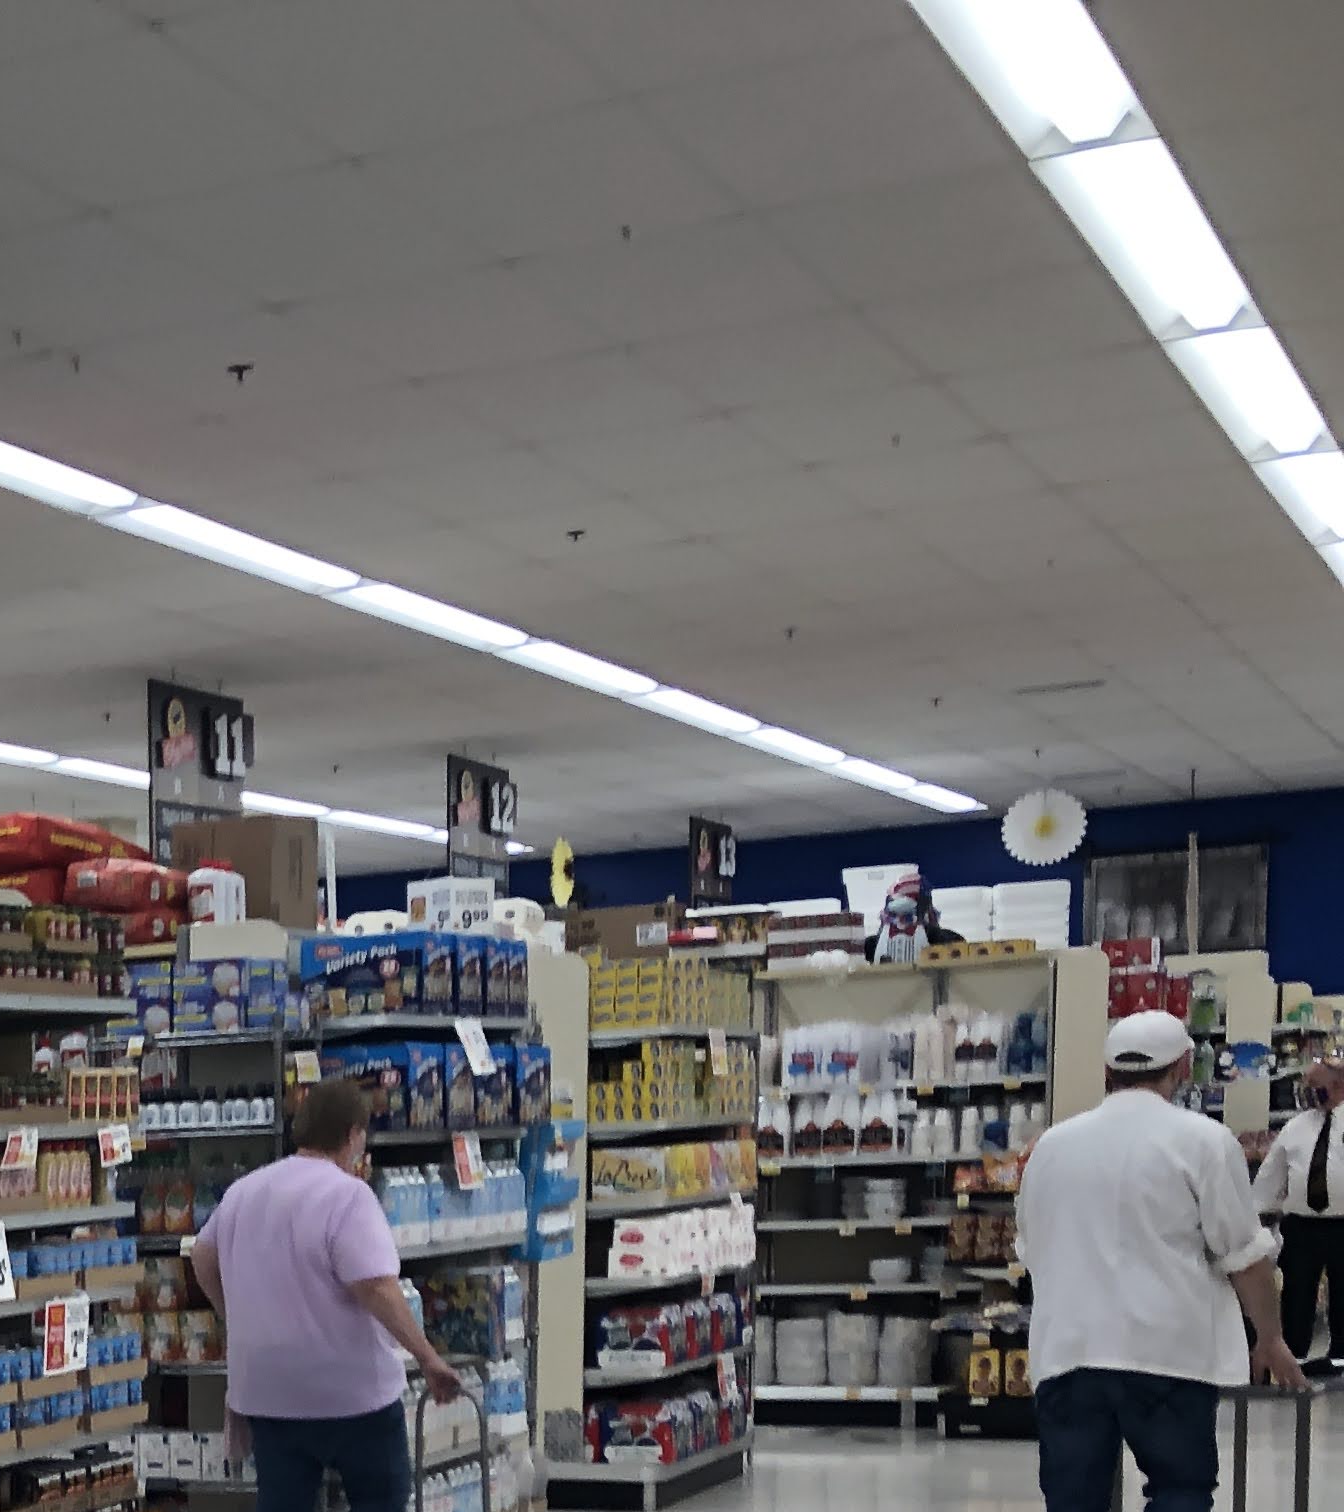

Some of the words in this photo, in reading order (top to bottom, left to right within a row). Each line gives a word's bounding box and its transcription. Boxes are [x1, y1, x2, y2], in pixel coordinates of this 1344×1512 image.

[215, 713, 247, 777] 11
[491, 781, 515, 834] 12
[326, 950, 368, 976] Variety
[370, 942, 398, 960] Pack
